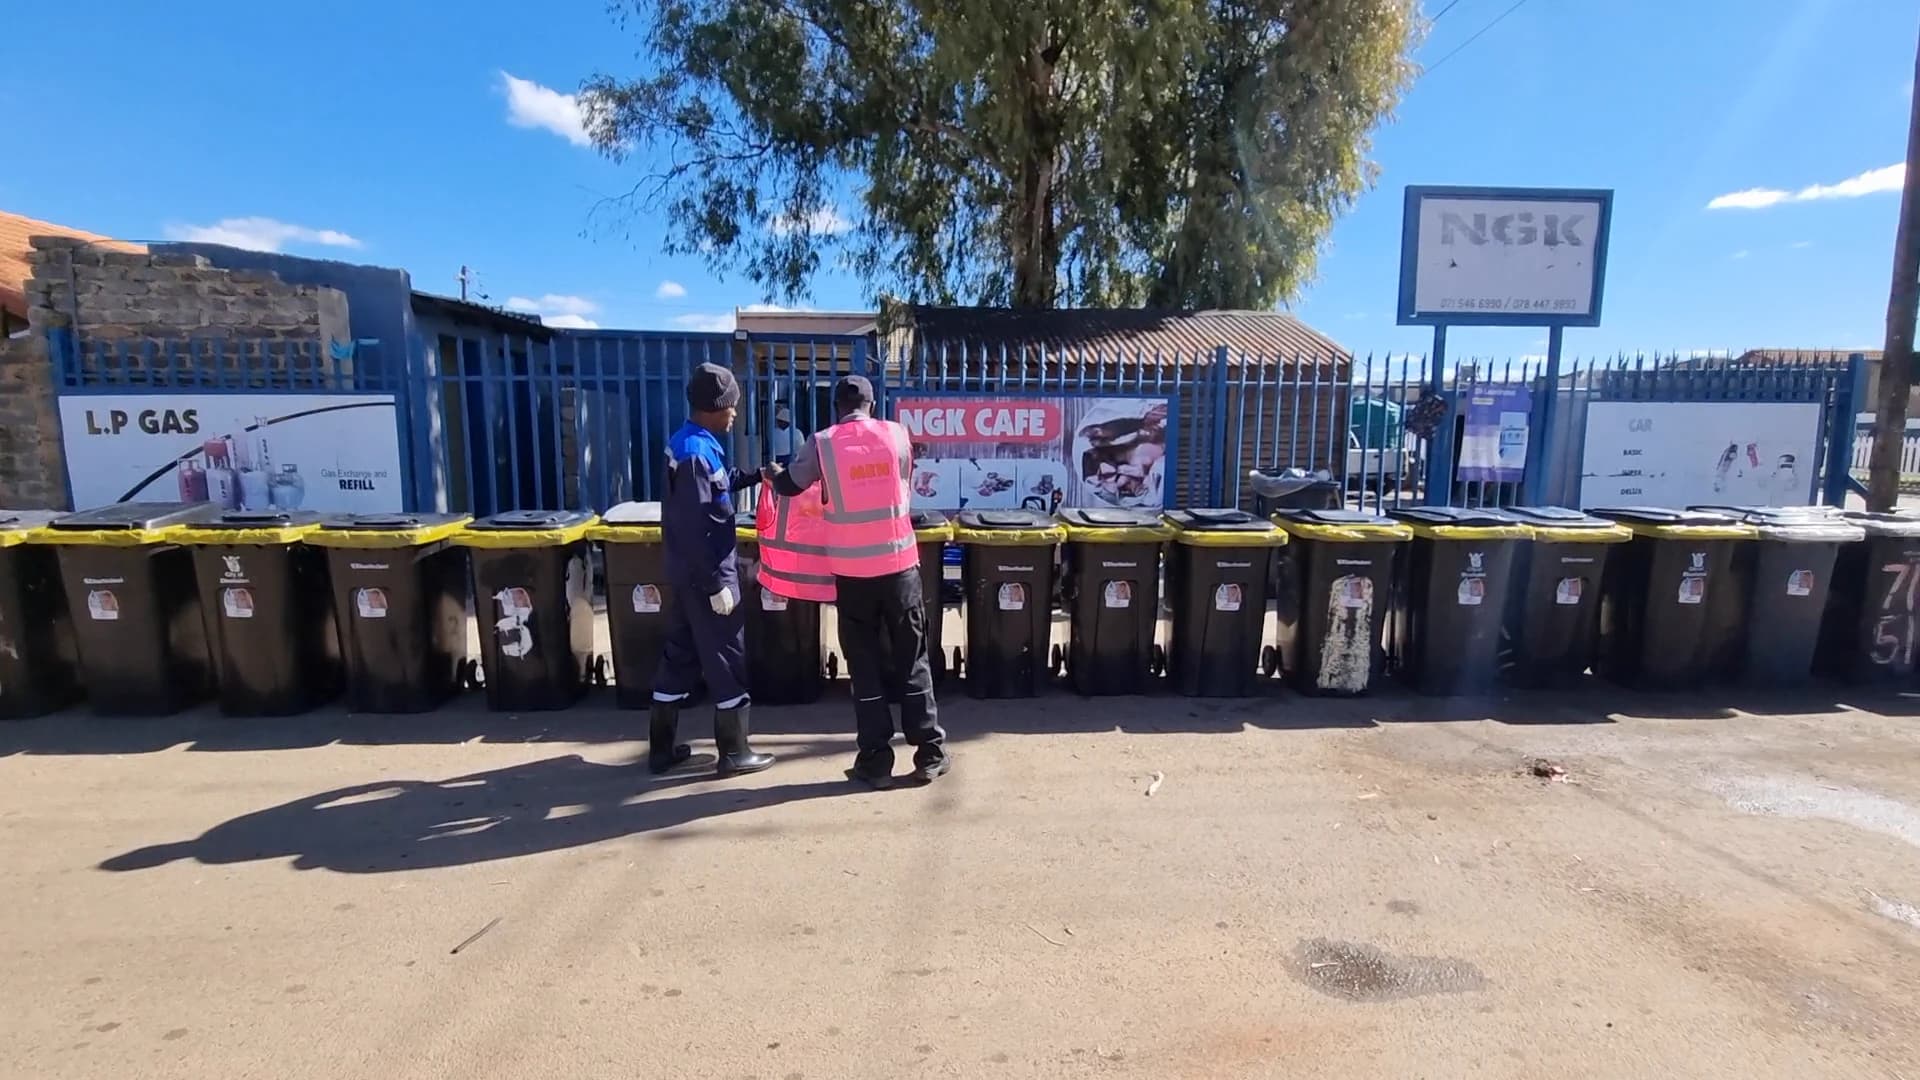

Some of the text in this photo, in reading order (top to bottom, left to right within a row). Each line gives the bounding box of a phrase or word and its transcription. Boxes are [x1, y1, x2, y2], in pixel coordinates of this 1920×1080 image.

[1440, 212, 1585, 246] NGK
[85, 409, 200, 435] L.P GAS
[900, 408, 1046, 437] NGK CAFE
[320, 468, 388, 480] Gas Exchange and
[339, 479, 375, 491] REFILL
